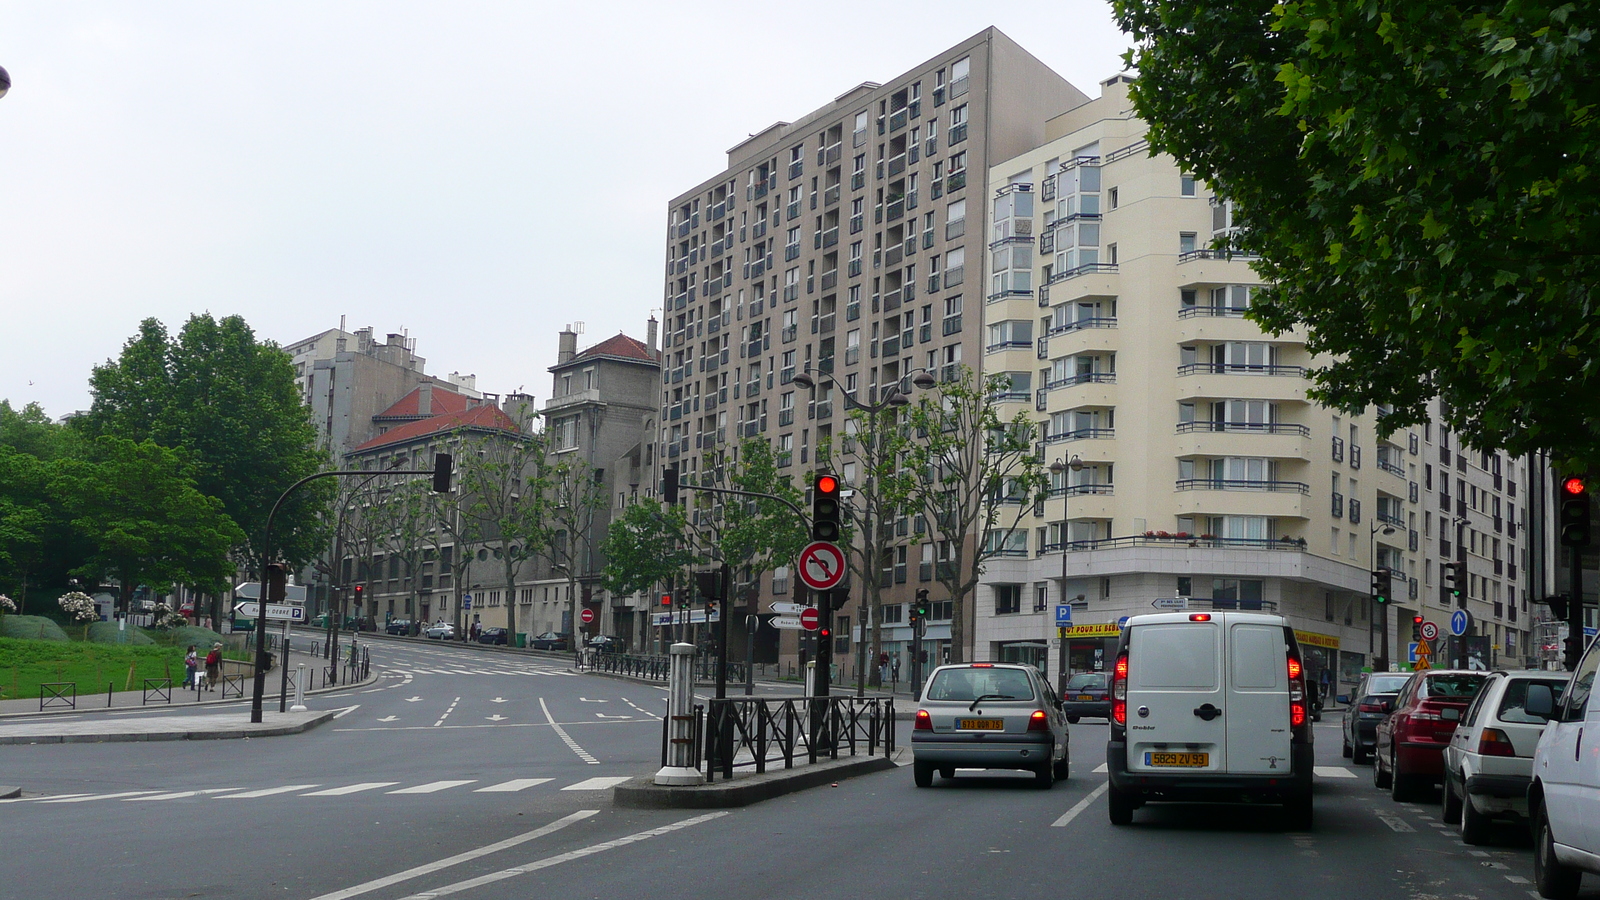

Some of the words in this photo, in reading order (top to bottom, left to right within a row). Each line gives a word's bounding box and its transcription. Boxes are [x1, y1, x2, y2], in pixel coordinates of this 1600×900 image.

[294, 609, 300, 617] P
[1060, 607, 1067, 618] P
[1424, 625, 1434, 637] 30
[962, 720, 975, 729] 673
[992, 720, 1000, 729] 75
[1153, 753, 1177, 764] 5829
[1178, 754, 1190, 765] ZV
[1192, 754, 1205, 765] 93
